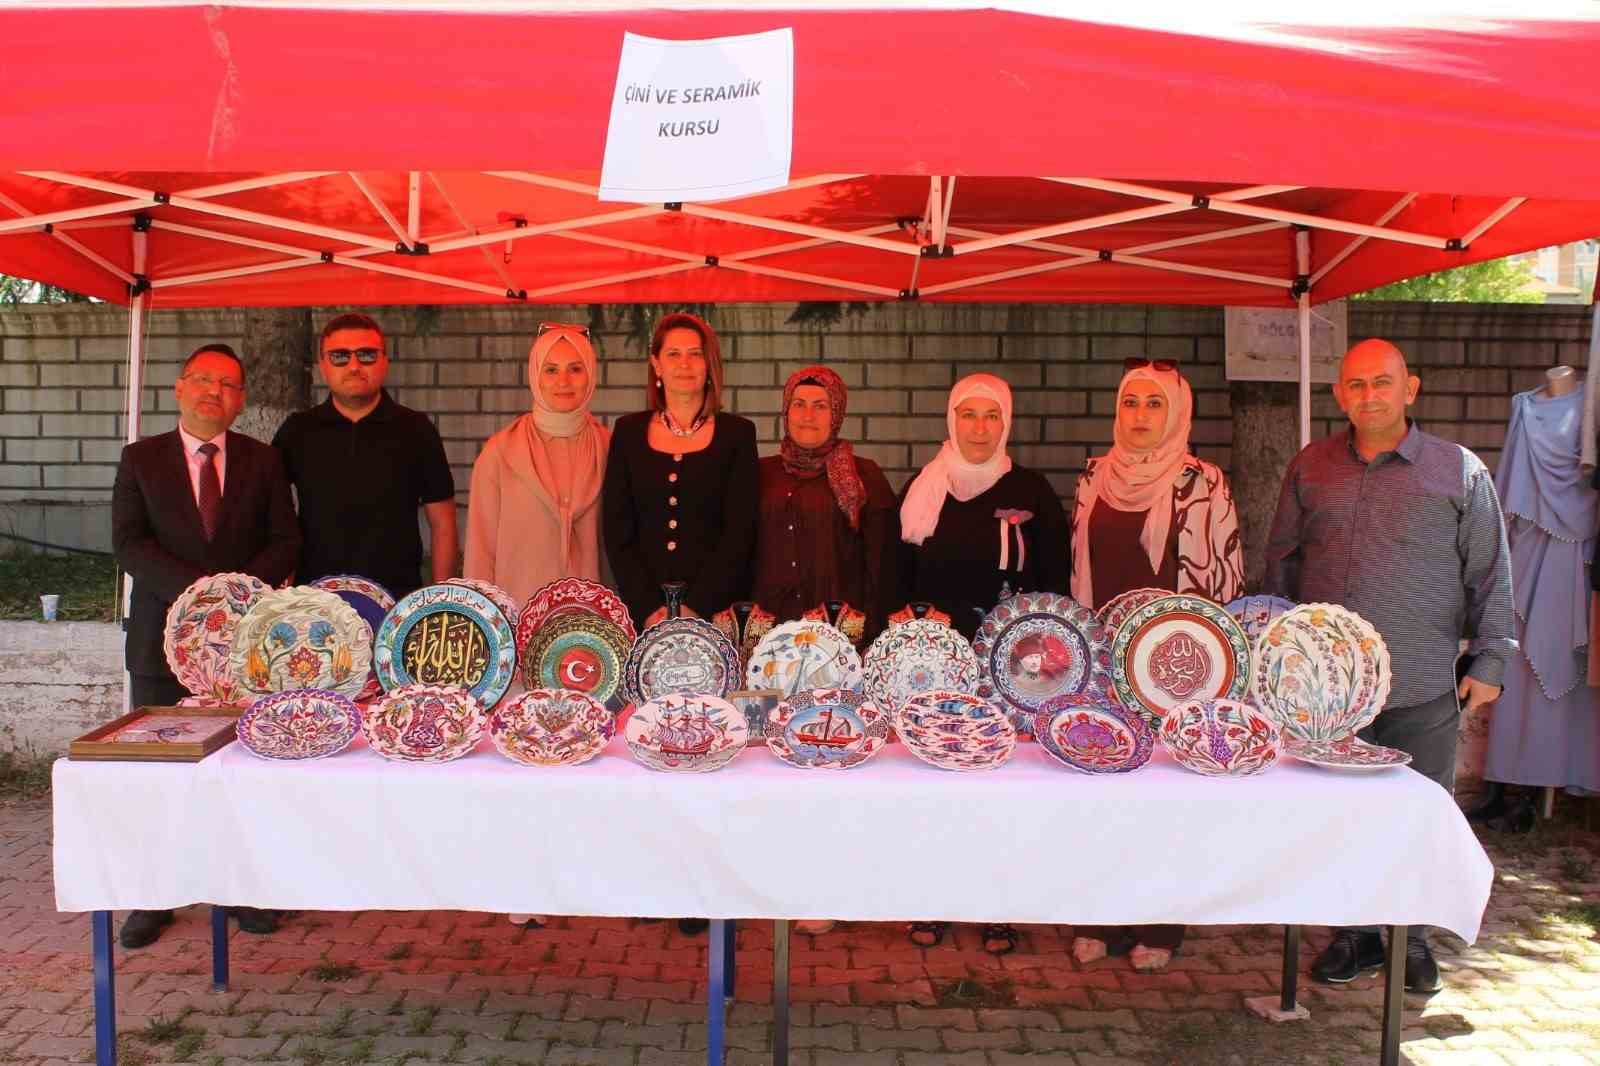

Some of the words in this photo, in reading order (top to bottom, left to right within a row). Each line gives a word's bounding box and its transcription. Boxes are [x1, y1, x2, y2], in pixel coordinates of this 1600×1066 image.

[625, 82, 652, 104] ÇİNİ
[655, 88, 678, 104] VE
[682, 78, 761, 104] SERAMİK
[657, 119, 720, 137] KURSU
